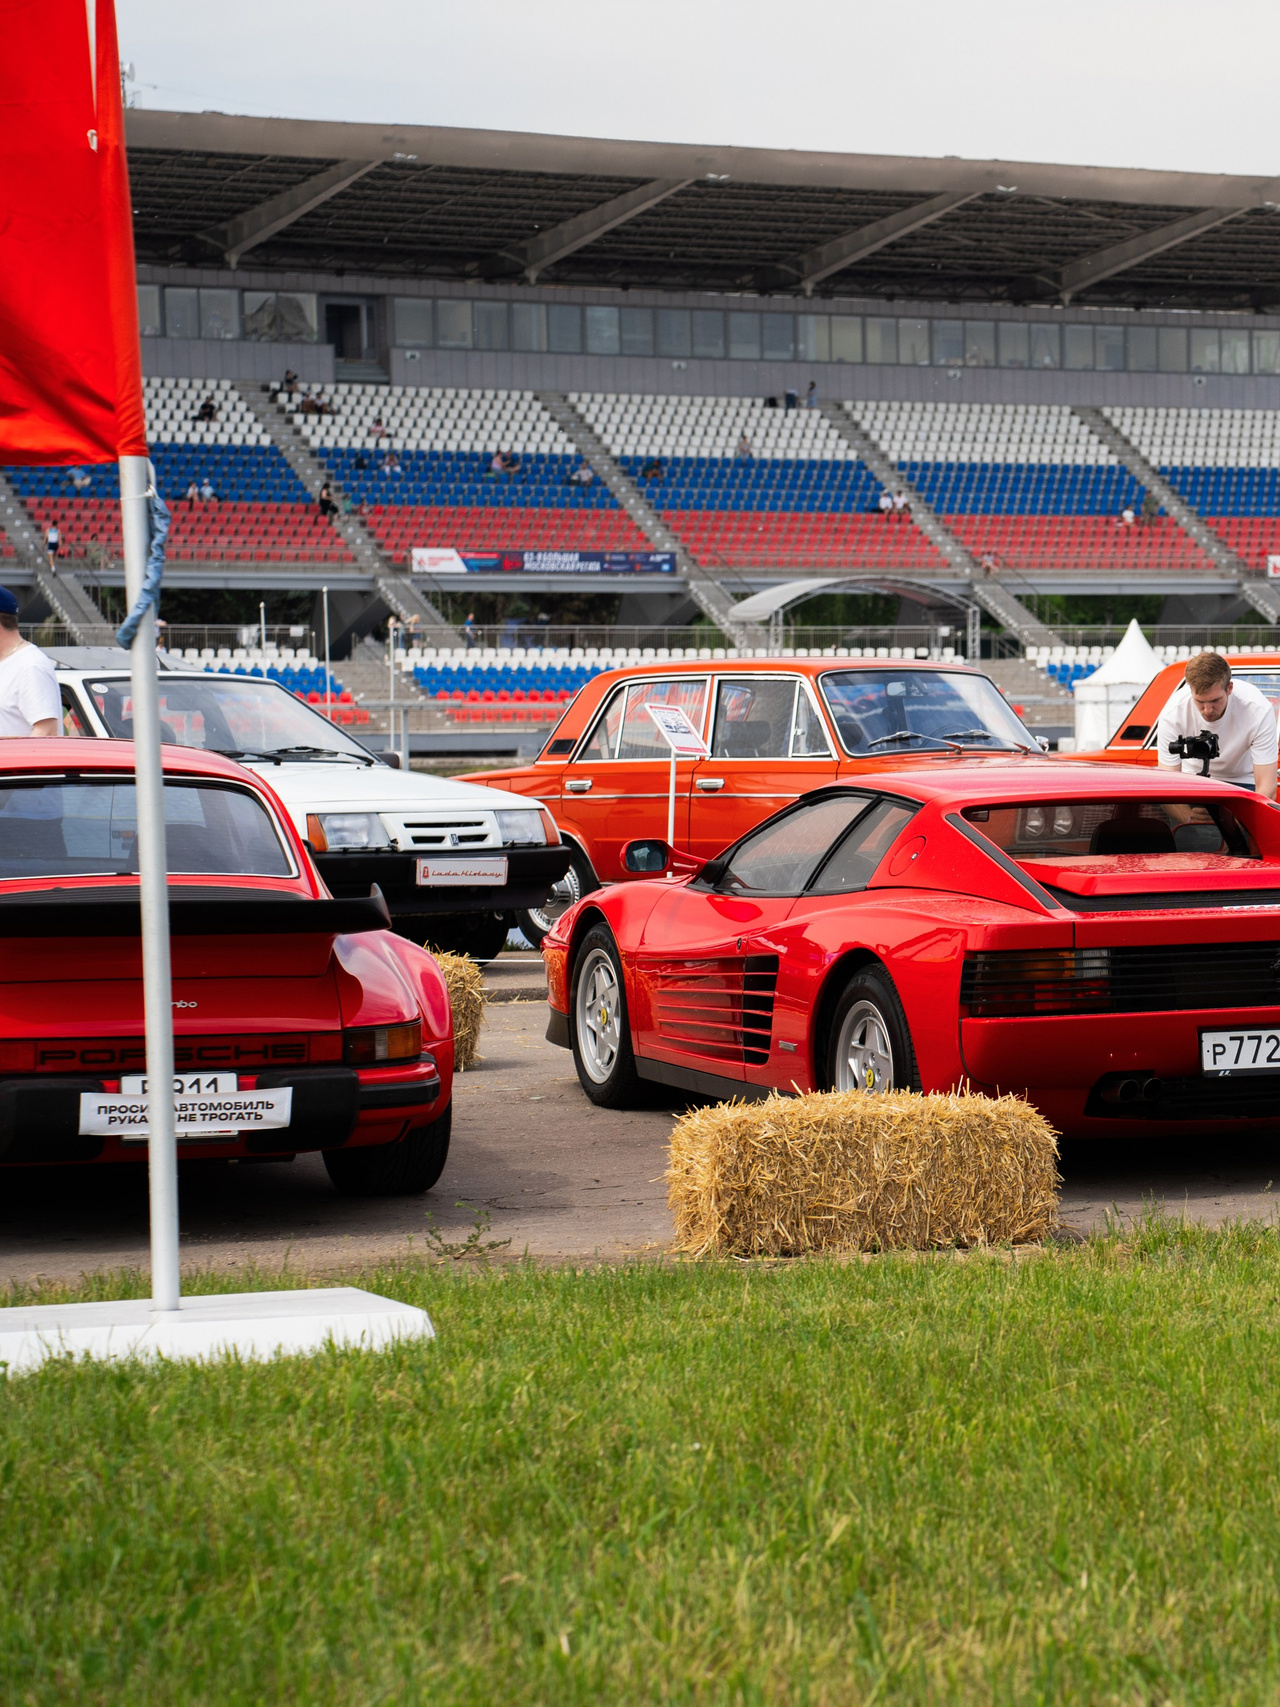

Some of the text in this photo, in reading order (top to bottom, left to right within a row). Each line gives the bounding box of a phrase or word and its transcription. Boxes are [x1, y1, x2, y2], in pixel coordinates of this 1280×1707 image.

[97, 1104, 149, 1115] ПРОСИ
[108, 1111, 264, 1125] РУКА НЕ ТРОГАТЬ
